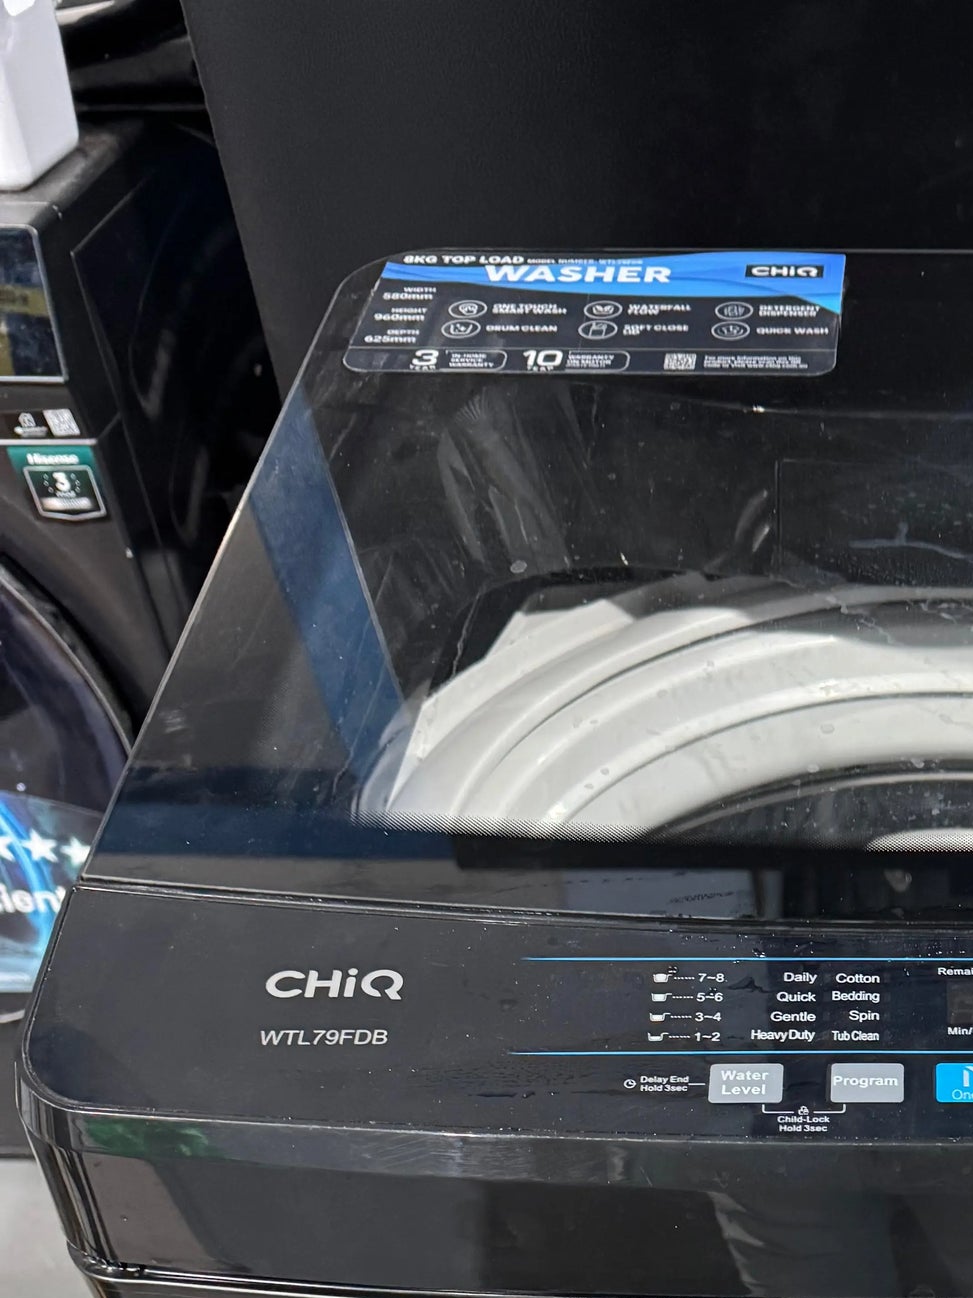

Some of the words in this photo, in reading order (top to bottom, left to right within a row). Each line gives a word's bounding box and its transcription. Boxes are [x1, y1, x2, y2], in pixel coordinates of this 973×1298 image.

[403, 255, 440, 264] 8KG
[441, 255, 476, 264] TOP
[479, 255, 524, 264] LOAD
[484, 265, 672, 283] WASHER
[521, 324, 558, 332] CLEAN
[793, 327, 829, 335] WASH
[412, 350, 439, 367] 3
[523, 350, 564, 367] 10
[265, 968, 404, 1001] CHiQ
[783, 972, 818, 985] Daily
[835, 973, 881, 984] Cotton
[776, 991, 817, 1003] Quick
[831, 990, 881, 1004] Bedding
[770, 1011, 817, 1022] Gentle
[848, 1010, 880, 1022] Spin
[260, 1029, 389, 1046] WTL79FDB
[750, 1030, 788, 1042] Heavy
[788, 1030, 816, 1042] Duty
[831, 1031, 850, 1041] Tub
[851, 1031, 880, 1041] Clean
[640, 1075, 669, 1085] Delay
[670, 1075, 690, 1084] End
[721, 1070, 770, 1082] Water
[833, 1075, 899, 1089] Program
[640, 1084, 663, 1092] Hold
[665, 1084, 688, 1092] 3sec
[721, 1084, 767, 1095] Level
[777, 1115, 830, 1124] Child-Lock
[779, 1124, 802, 1132] Hold
[804, 1124, 828, 1133] 3sec
